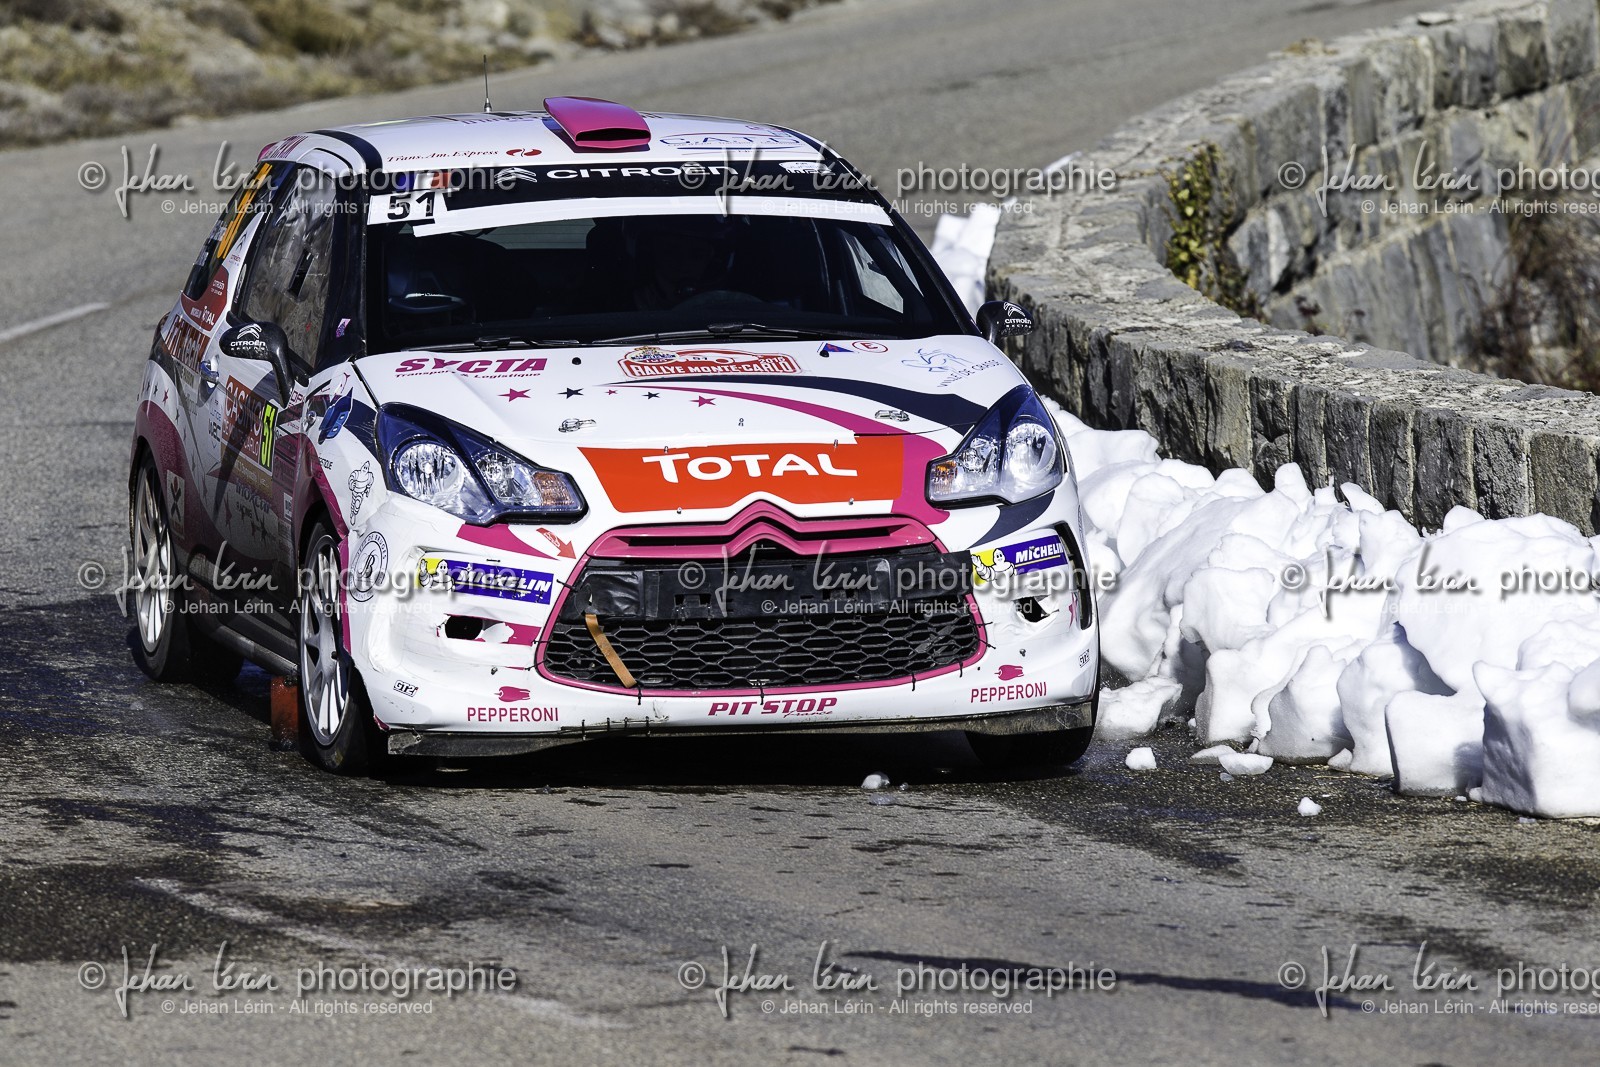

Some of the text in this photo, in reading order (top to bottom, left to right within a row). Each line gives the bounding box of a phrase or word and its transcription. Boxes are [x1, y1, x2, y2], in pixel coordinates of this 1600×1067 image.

[387, 192, 435, 220] 51
[395, 357, 548, 374] SYCTA
[630, 361, 793, 376] RALLYE MONTE-CARLO
[226, 382, 262, 436] CASINO
[262, 404, 275, 468] 51
[642, 453, 858, 483] TOTAL
[1015, 543, 1064, 564] MICHELIN
[457, 569, 553, 592] MICHELIN
[970, 682, 1048, 703] PEPPERONI
[467, 707, 560, 722] PEPPERONI
[708, 697, 838, 716] PIT STOP
